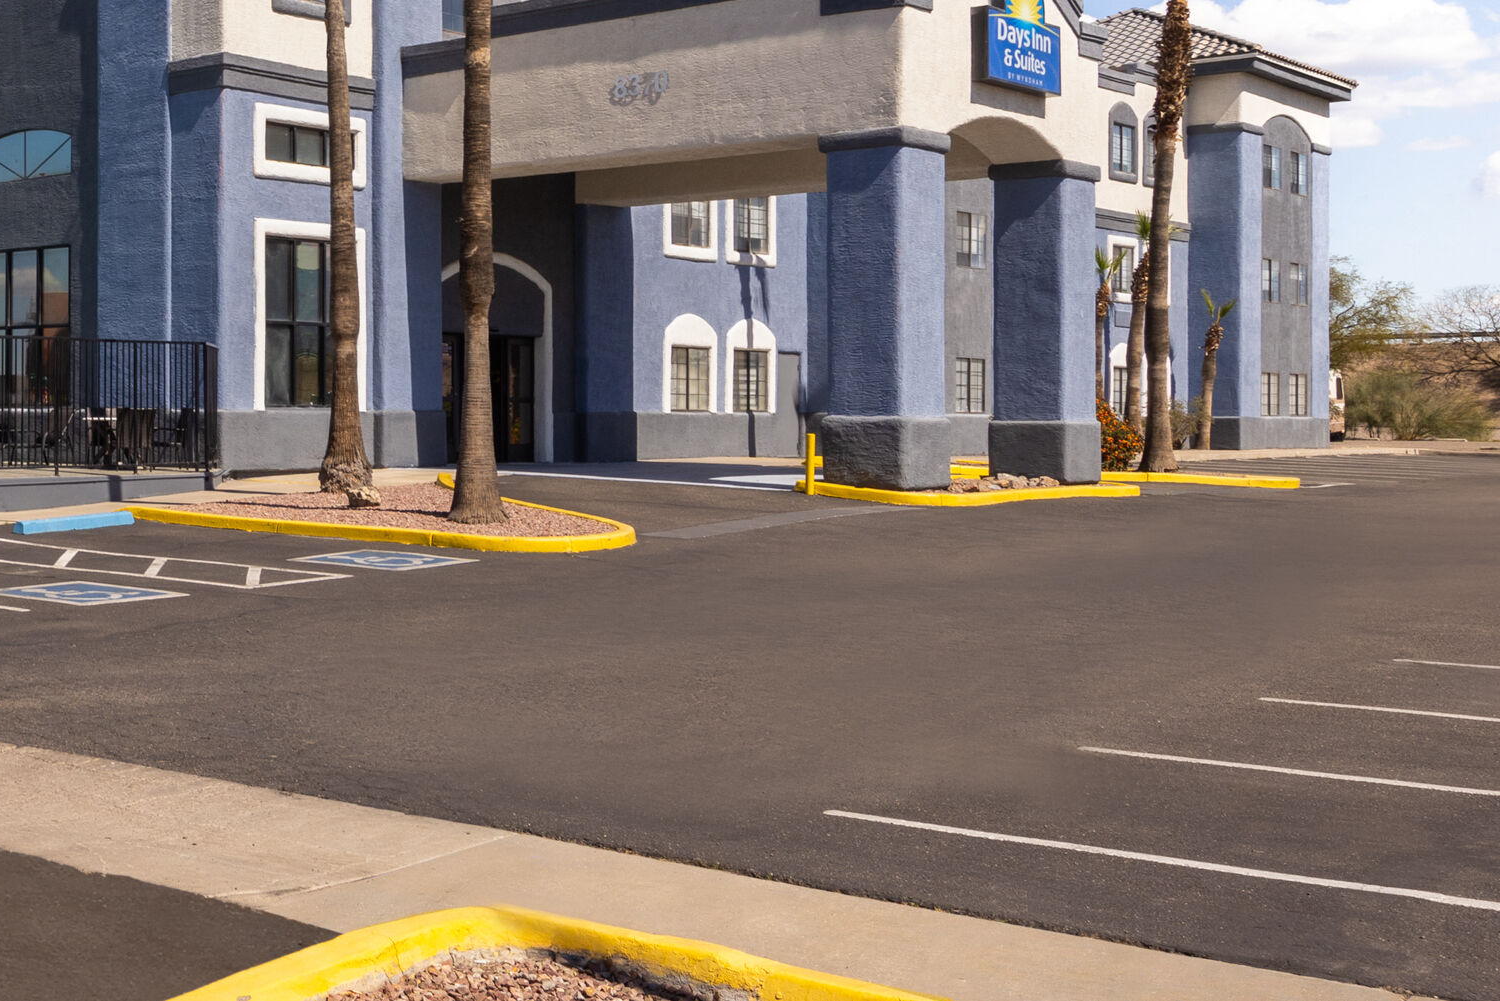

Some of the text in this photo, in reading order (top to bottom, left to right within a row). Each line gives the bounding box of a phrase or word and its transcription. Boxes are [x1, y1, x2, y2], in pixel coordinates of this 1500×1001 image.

[997, 18, 1051, 54] Days Inn
[1004, 48, 1046, 75] & Suites
